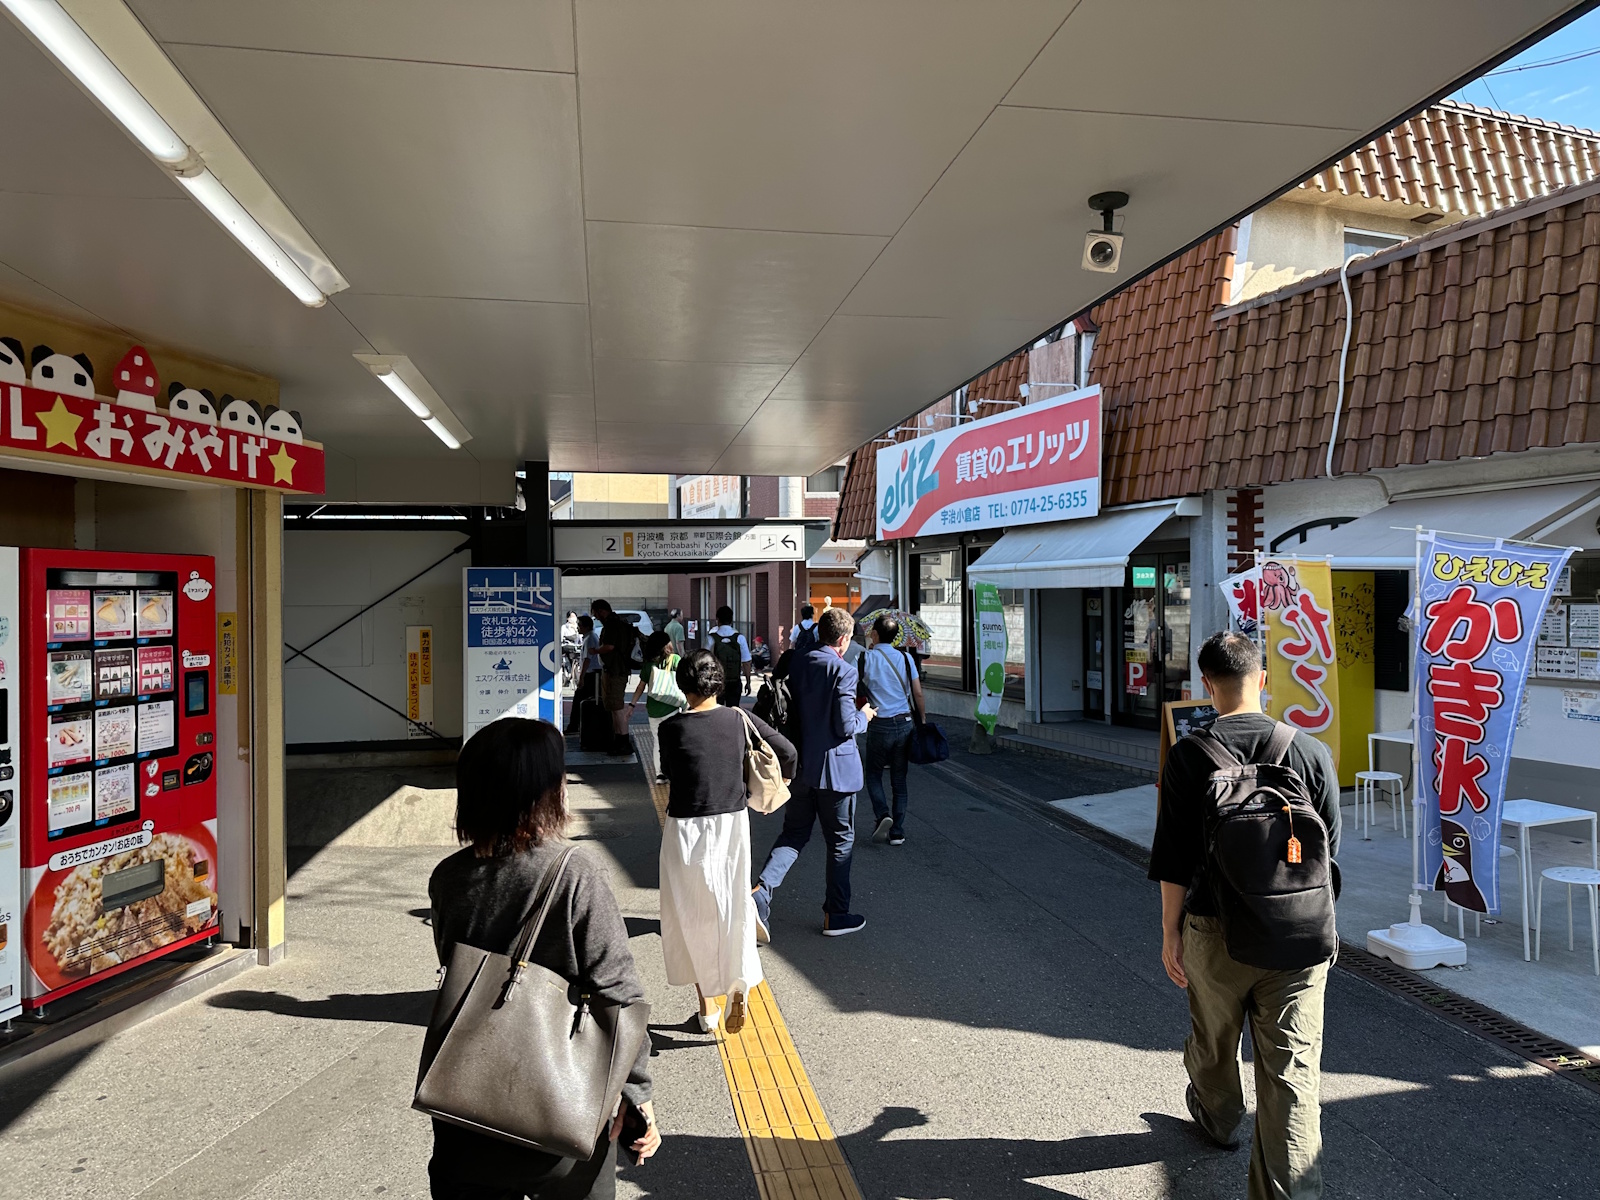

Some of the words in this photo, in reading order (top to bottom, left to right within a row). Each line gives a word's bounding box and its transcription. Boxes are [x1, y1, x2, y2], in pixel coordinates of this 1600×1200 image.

[84, 402, 268, 479] おみやげ
[955, 419, 1090, 485] 賃貸のエリッツ
[940, 505, 980, 525] 宇治小倉店
[988, 503, 1008, 519] TEL:
[1011, 490, 1088, 516] 0774-25-6355
[606, 538, 616, 551] 2
[626, 537, 632, 545] B
[637, 532, 665, 541] 丹波橋
[670, 532, 689, 541] 京都
[704, 542, 728, 550] Kyoto
[637, 550, 719, 559] Kyoto-Kokusaikaikan
[1434, 552, 1551, 590] ひえひえ
[482, 616, 537, 625] 改札口を左へ
[481, 626, 538, 638] 徒歩約4分
[475, 674, 531, 682] エスワイズ株式会社
[1129, 663, 1144, 685] P
[60, 834, 144, 866] おうちでカンタン!お店の味
